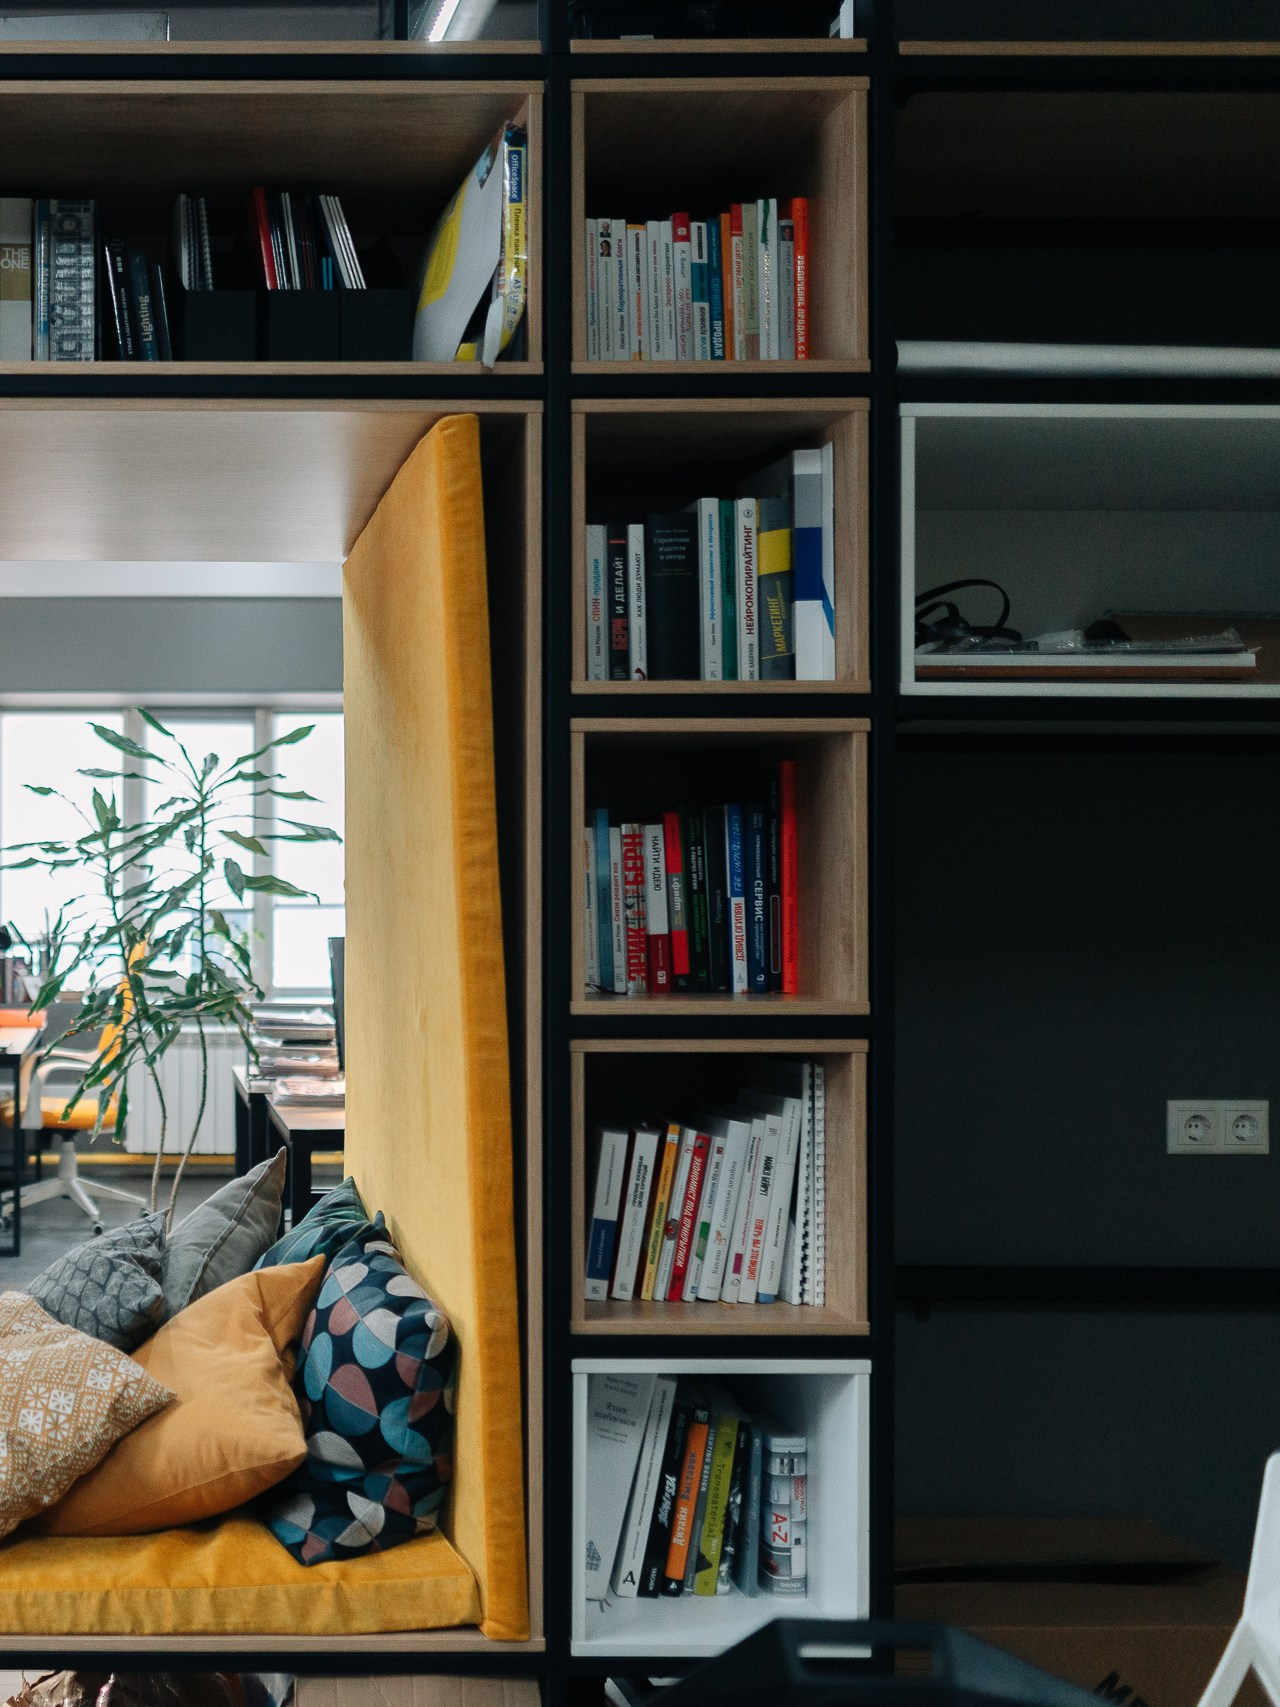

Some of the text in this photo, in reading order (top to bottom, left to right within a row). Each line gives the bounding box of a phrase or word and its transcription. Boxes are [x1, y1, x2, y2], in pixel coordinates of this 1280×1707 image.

[510, 154, 518, 199] OfficeSpace
[513, 208, 521, 236] Пленка
[0, 258, 28, 269] ONE
[1, 247, 28, 258] THE
[39, 267, 49, 322] Makeovers
[798, 255, 806, 306] УВЕЛИЧЕНИЕ
[120, 288, 134, 355] STAGE LIGHTING DESIGN
[138, 295, 154, 342] Lighting
[712, 320, 723, 357] ПРОДАЖ
[797, 309, 806, 343] ПРОДАЖ
[614, 556, 626, 602] ДЕЛАЙ!
[635, 552, 643, 581] ДУМАЮТ
[743, 525, 755, 635] НЕЙРОКОПИРАЙТИНГ
[615, 606, 625, 614] И
[766, 595, 788, 652] МАРКЕТИНГ
[623, 833, 645, 887] БЕРН
[650, 835, 661, 892] НАЙТИ ИДЕЮ
[613, 874, 621, 901] решают
[753, 880, 763, 922] СЕРВИС
[733, 902, 745, 962] ДЭВИД ОГИЛВИ
[687, 1156, 703, 1200] ЭКОНОМИСТ
[726, 1160, 737, 1189] дизайна
[759, 1155, 774, 1197] МАЙКЛ БЕЙРУТ
[683, 1200, 695, 1216] ПОД
[721, 1189, 733, 1223] помощью
[675, 1217, 692, 1268] ПРИКРЫТИЕМ
[711, 1249, 722, 1275] Каплан
[746, 1218, 765, 1281] ТЕПЕРЬ ВЫ ЭТО ВИДИТЕ
[679, 1451, 697, 1501] Выставок
[701, 1428, 716, 1492] LIGHTING DESIGN
[664, 1472, 678, 1496] YES
[672, 1506, 689, 1546] Дизайн
[707, 1463, 725, 1555] Transmaterial Next
[771, 1512, 788, 1544] A-Z
[648, 1567, 658, 1591] TASCHEN
